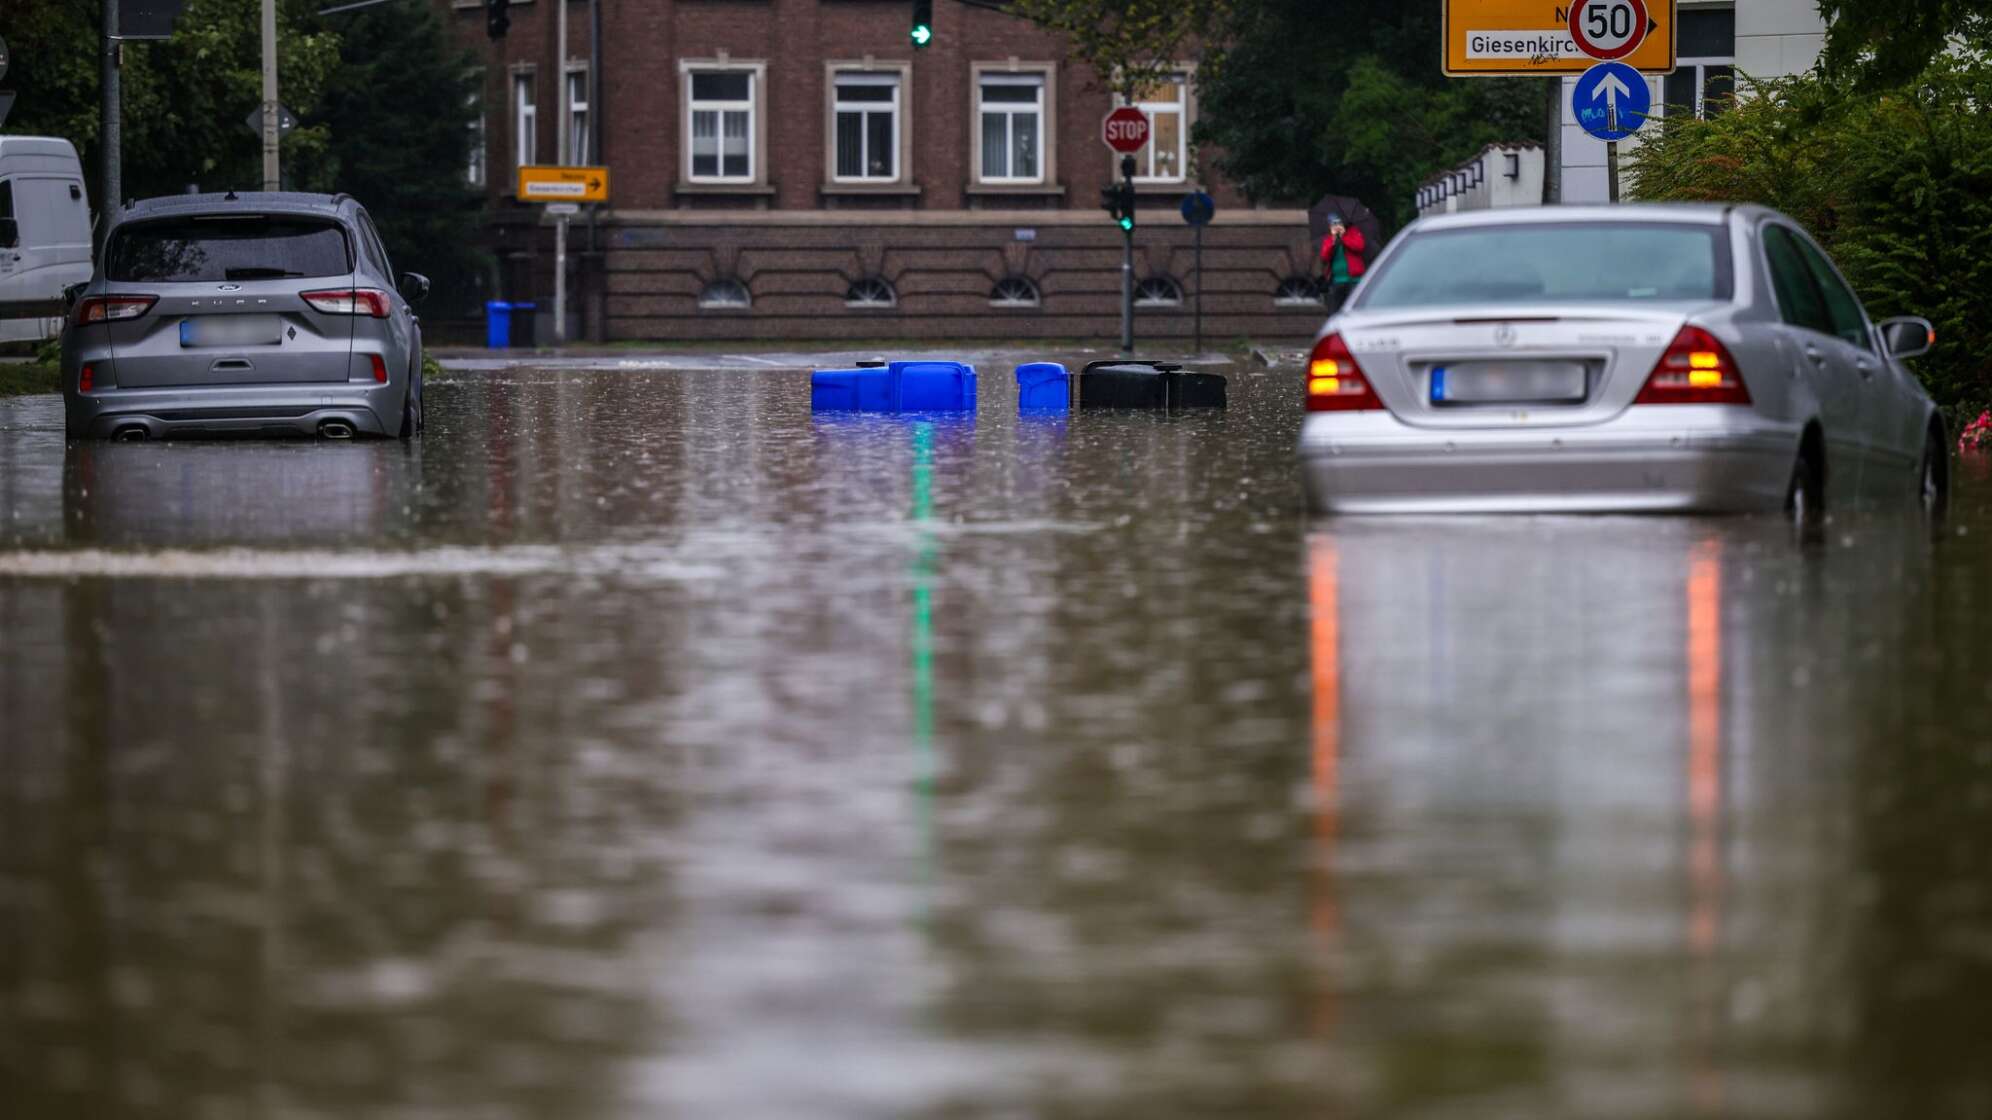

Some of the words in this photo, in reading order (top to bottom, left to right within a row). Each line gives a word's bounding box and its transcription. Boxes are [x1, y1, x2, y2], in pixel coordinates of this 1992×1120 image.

[1555, 6, 1569, 23] N
[1588, 4, 1630, 39] 50
[1472, 35, 1579, 53] Giesenkirc
[1107, 120, 1147, 140] STOP
